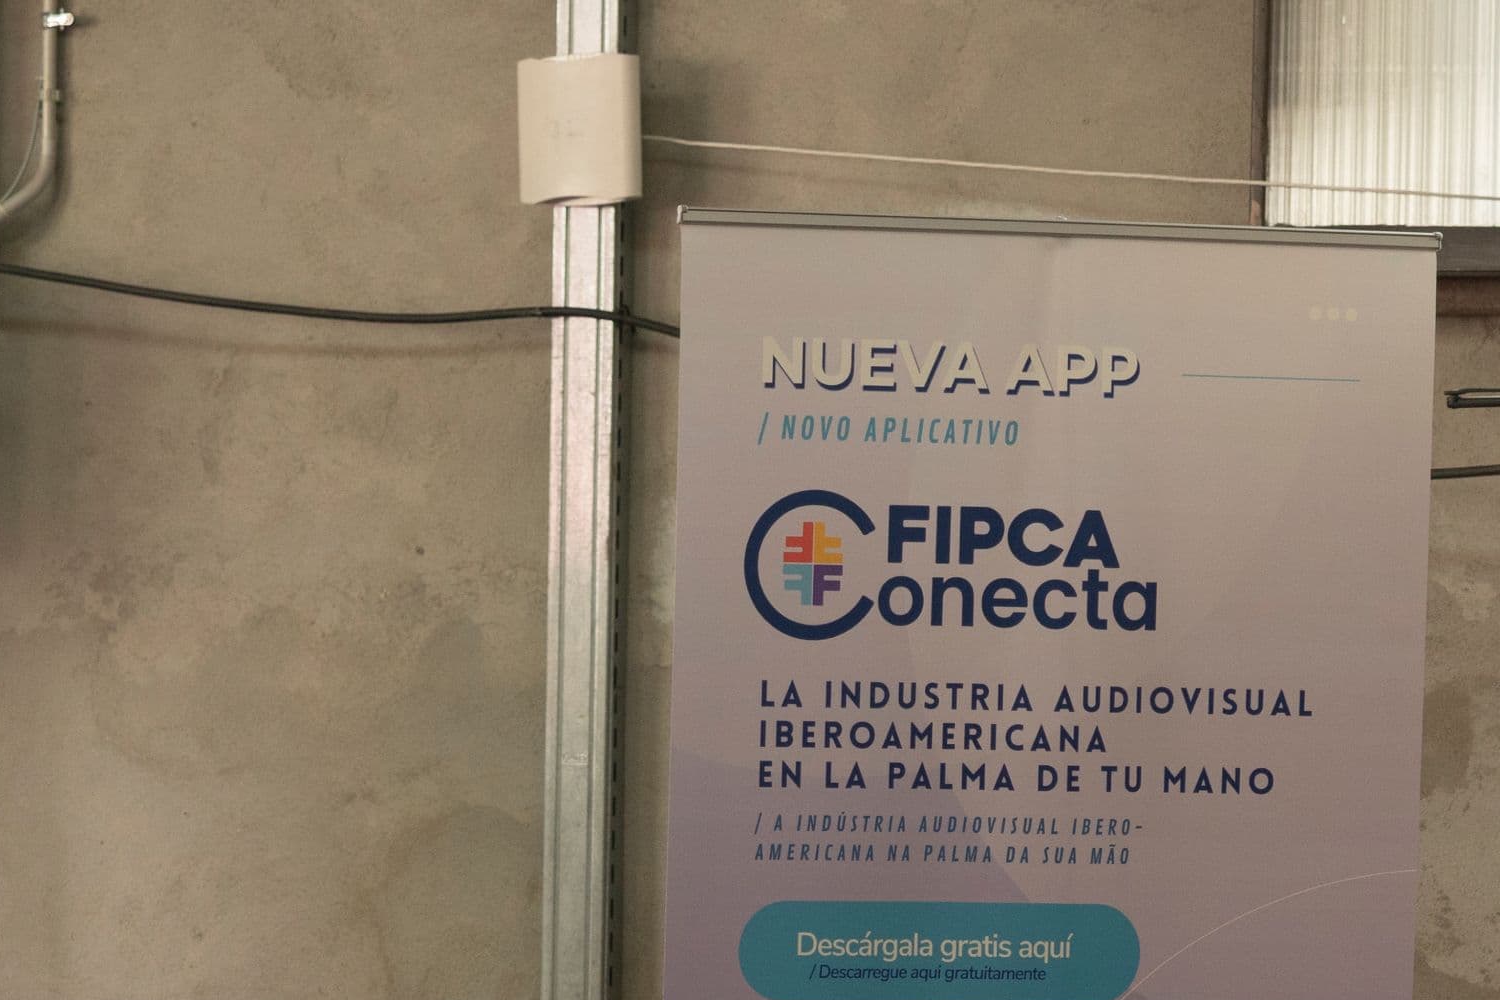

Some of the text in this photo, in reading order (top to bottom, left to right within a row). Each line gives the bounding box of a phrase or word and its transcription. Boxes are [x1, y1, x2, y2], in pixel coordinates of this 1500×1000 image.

[761, 335, 1140, 398] NUEVA APP
[781, 414, 851, 442] NOVO
[864, 416, 1019, 446] APLICATIVO
[887, 504, 1120, 569] FIPCA
[760, 680, 1313, 717] LA INDUSTRIA AUDIOVISUAL
[759, 719, 1107, 753] IBEROAMERICANA
[758, 760, 1275, 795] EN LA PALMA DE TU MANO
[774, 814, 783, 831] A
[797, 812, 906, 833] INDÚSTRIA
[919, 815, 1059, 835] AUDIOVISUAL
[1072, 818, 1143, 836] IBERO-
[755, 844, 1130, 864] AMERICANA NA PALMA DA SUA MÃO
[796, 930, 1074, 964] Descárgala gratis aquí
[819, 965, 907, 982] Descarregue
[945, 966, 1046, 982] gratuitamente
